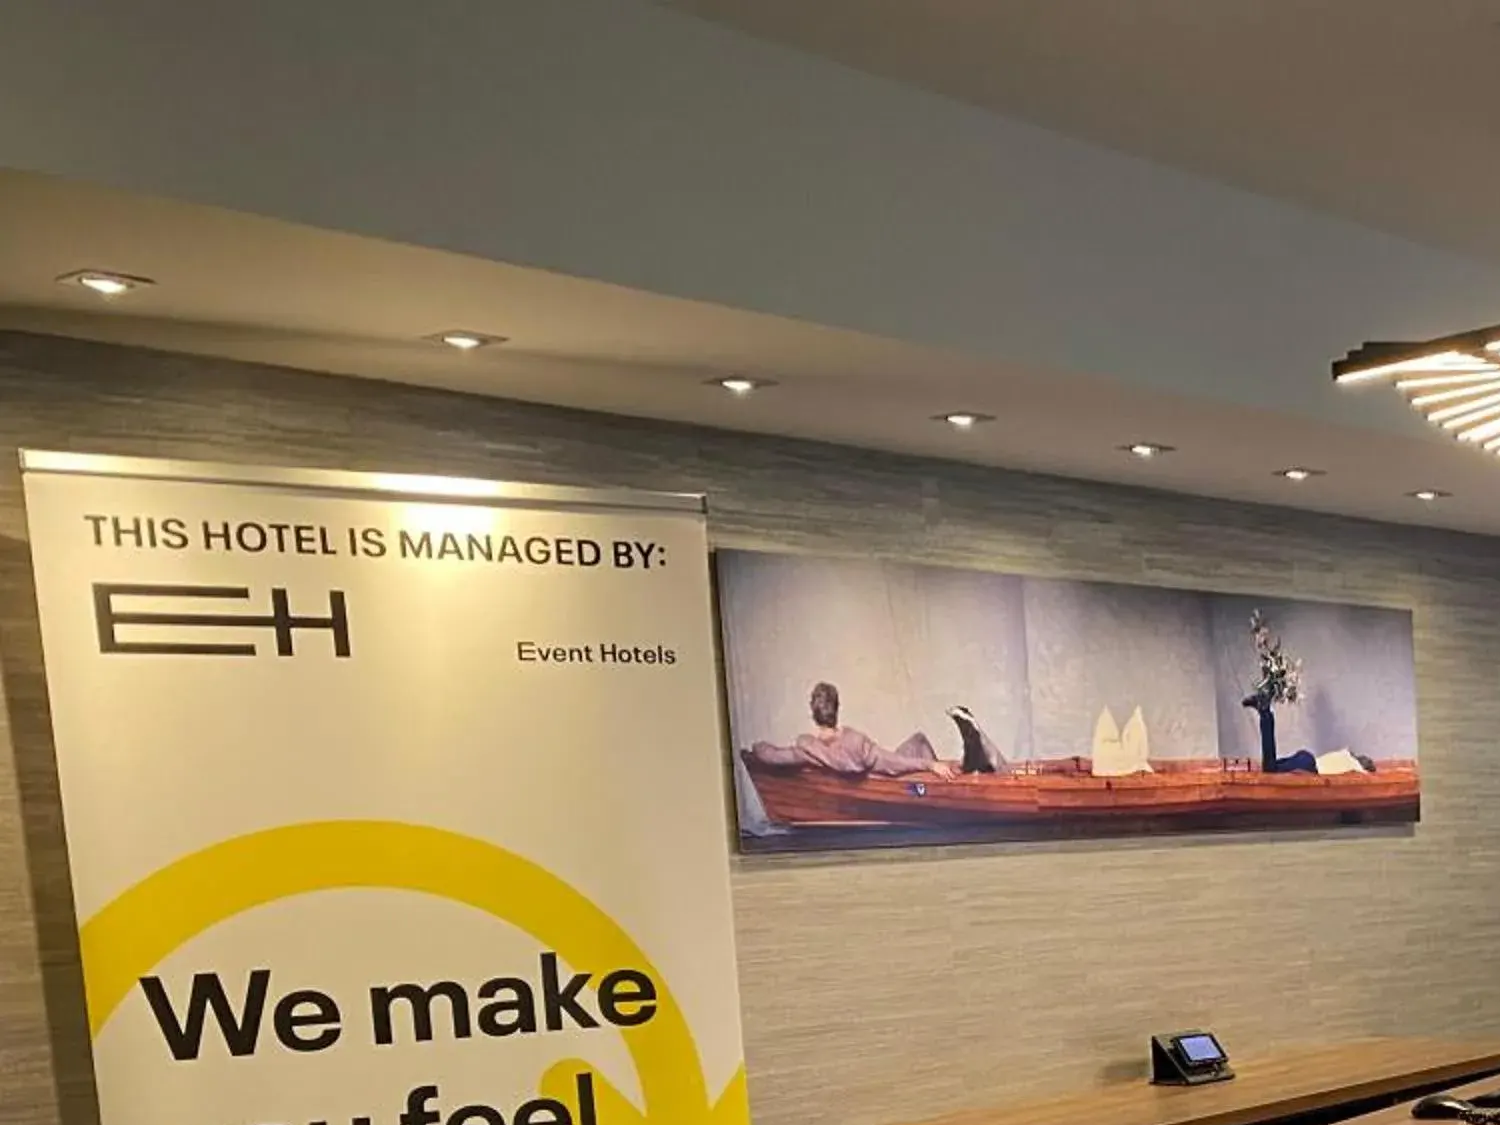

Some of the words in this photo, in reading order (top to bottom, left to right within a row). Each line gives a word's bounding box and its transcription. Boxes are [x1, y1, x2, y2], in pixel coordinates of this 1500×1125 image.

[84, 515, 189, 550] THIS
[203, 521, 337, 556] HOTEL
[348, 527, 387, 558] IS
[399, 529, 602, 567] MANAGED
[613, 541, 667, 570] BY:
[92, 582, 351, 658] EH
[517, 642, 593, 664] Event
[600, 643, 677, 665] Hotels
[139, 969, 342, 1061] We
[371, 952, 658, 1045] make
